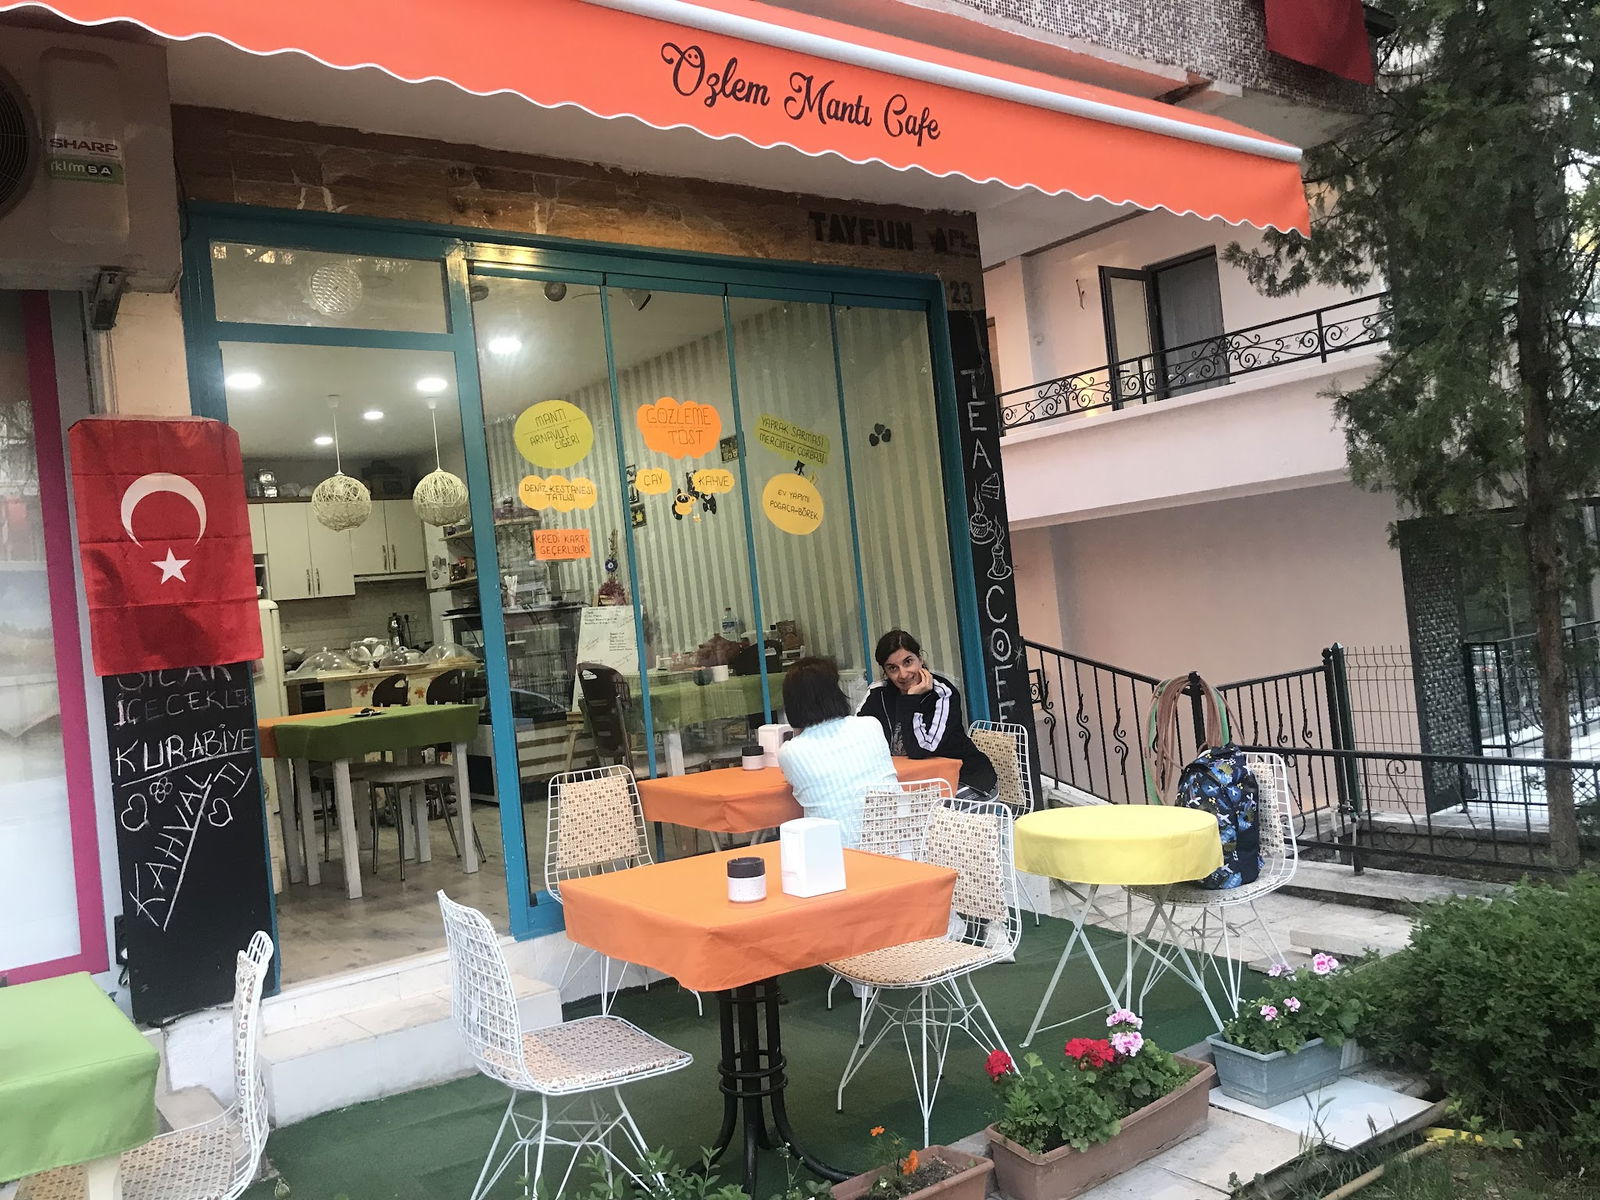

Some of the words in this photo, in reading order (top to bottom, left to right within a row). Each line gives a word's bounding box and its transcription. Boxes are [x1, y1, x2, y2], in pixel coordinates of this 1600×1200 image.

[660, 42, 770, 108] Özlem
[784, 72, 872, 127] Mantı
[883, 94, 940, 146] Cafe
[49, 138, 118, 153] SHARP
[808, 211, 914, 251] TAYFUN
[950, 280, 973, 304] 23
[535, 408, 567, 428] MANTI
[960, 368, 992, 469] TEA
[529, 425, 570, 446] ARNAVUT
[668, 429, 703, 445] TOST
[761, 416, 789, 435] YAPRAK
[791, 426, 824, 447] SARMASI
[698, 475, 730, 487] KAHVE
[129, 761, 253, 928] KAHVALTI
